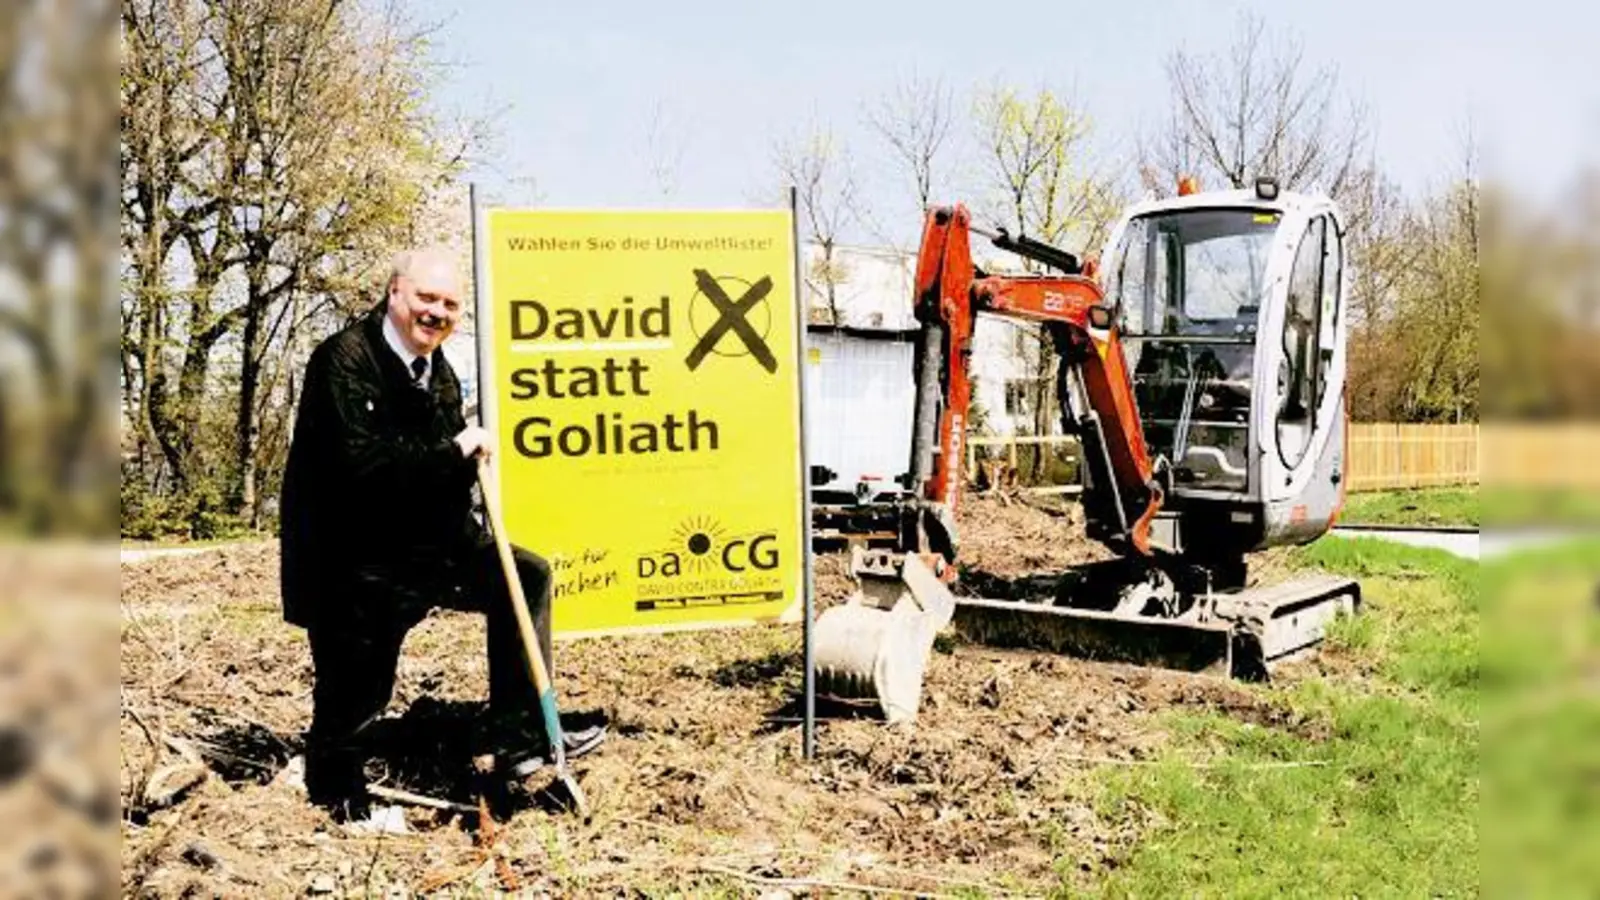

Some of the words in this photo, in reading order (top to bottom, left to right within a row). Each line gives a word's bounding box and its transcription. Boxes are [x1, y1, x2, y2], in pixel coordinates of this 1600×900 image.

[586, 237, 617, 251] Sie
[621, 236, 650, 251] die
[656, 236, 773, 251] Umweltliste!
[509, 297, 672, 341] David
[510, 357, 651, 400] statt
[512, 409, 720, 460] Goliath
